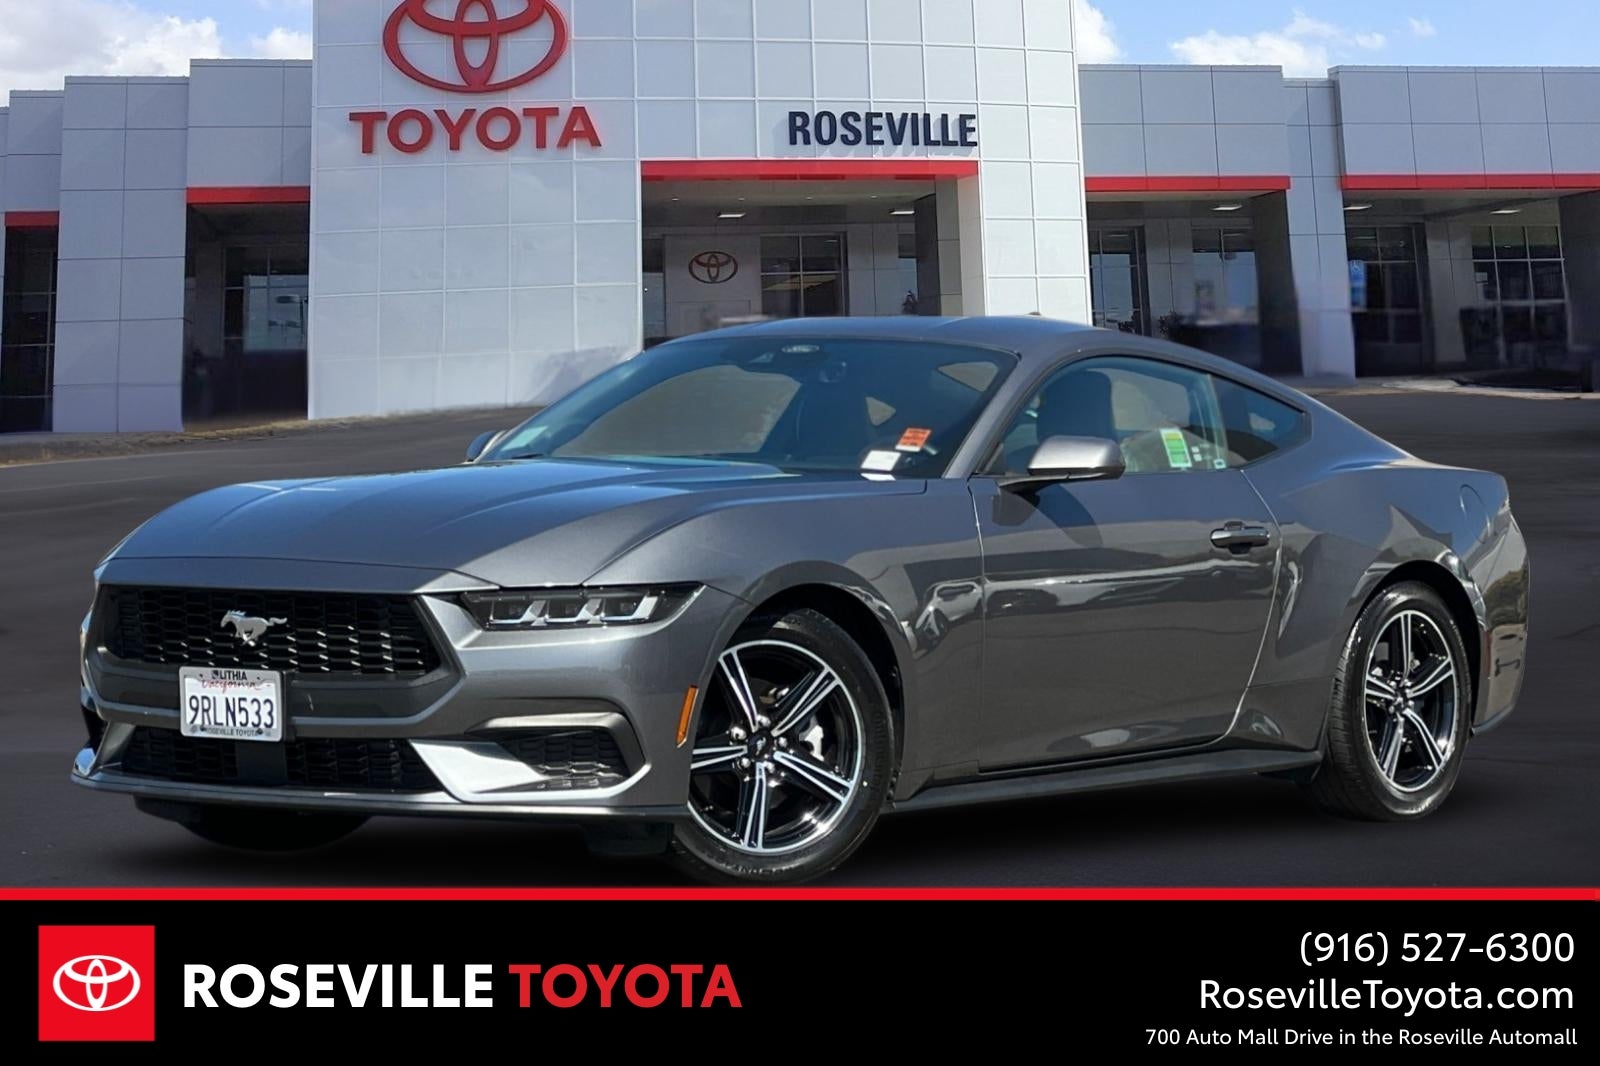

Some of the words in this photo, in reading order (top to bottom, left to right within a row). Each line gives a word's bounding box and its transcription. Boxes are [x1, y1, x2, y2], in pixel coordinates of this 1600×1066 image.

[349, 105, 602, 154] TOYOTA
[788, 110, 978, 147] ROSEVILLE
[220, 669, 247, 681] LITHIA
[189, 694, 274, 729] 9RLN533
[203, 727, 234, 736] OSEVILLE
